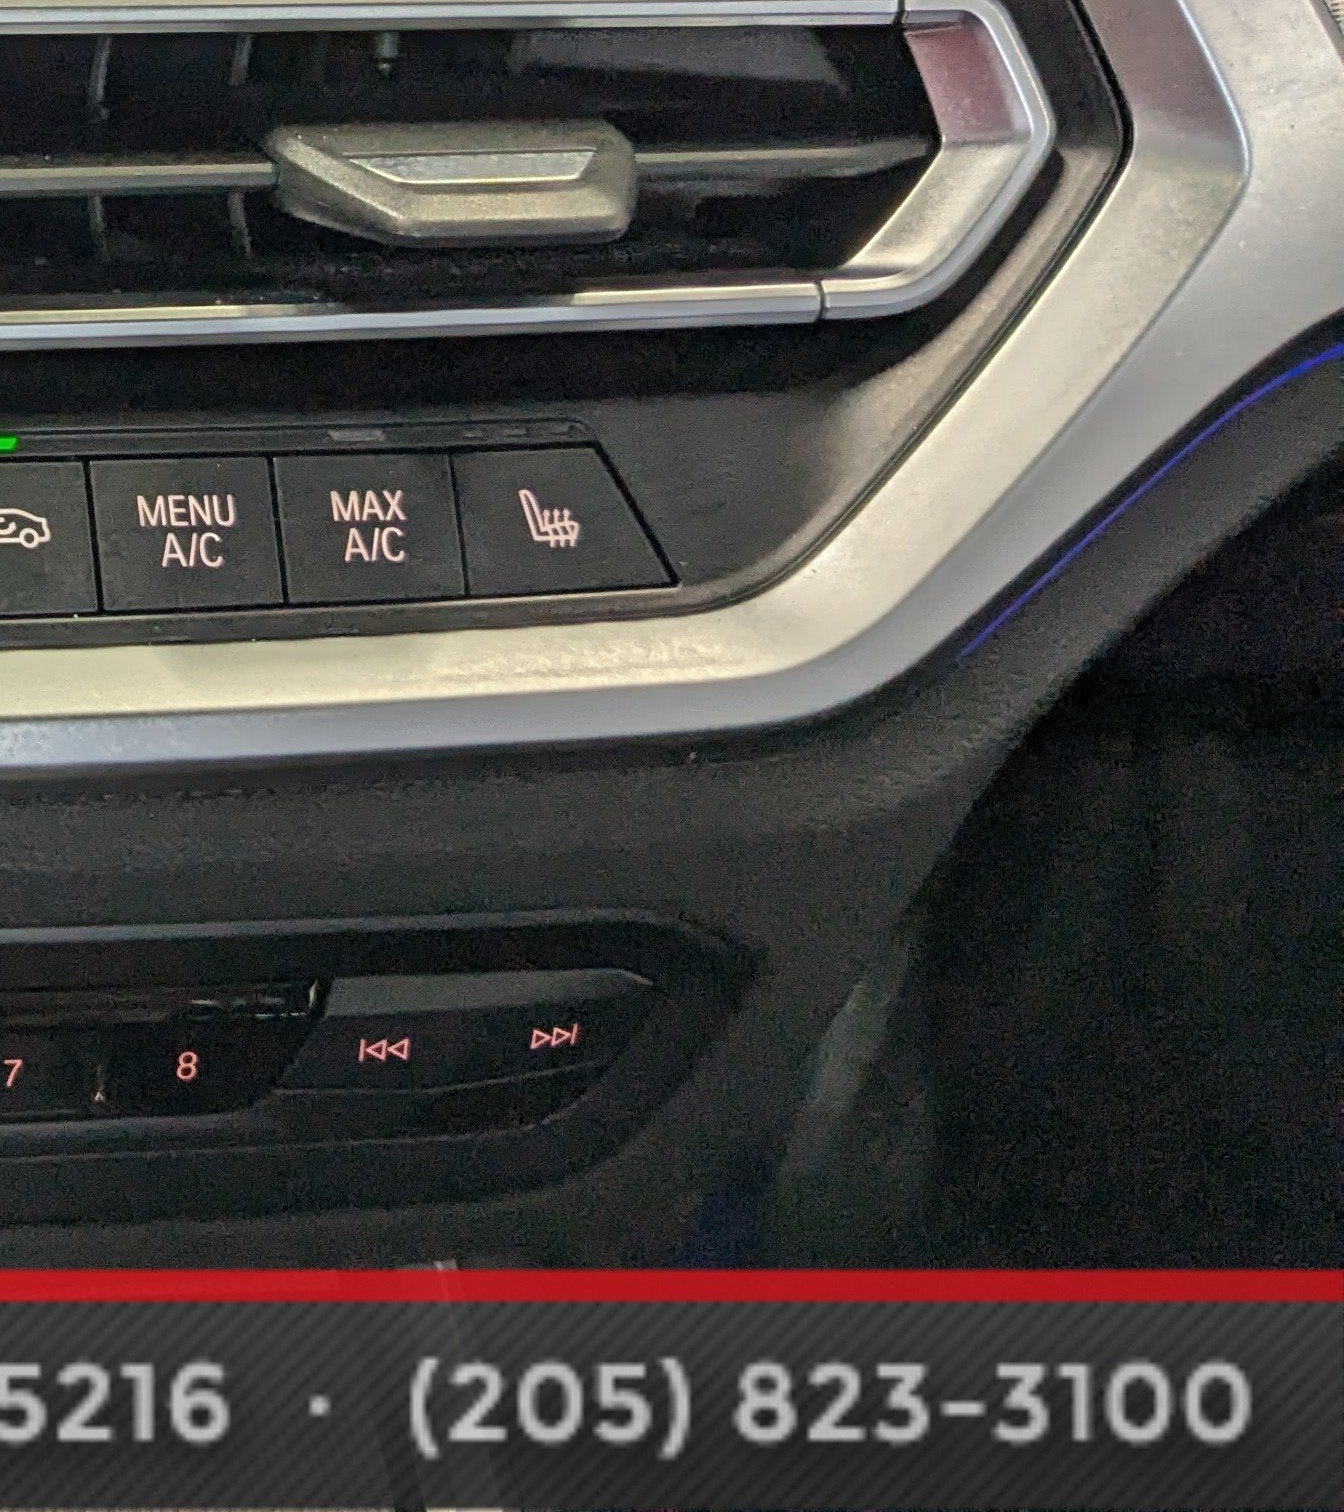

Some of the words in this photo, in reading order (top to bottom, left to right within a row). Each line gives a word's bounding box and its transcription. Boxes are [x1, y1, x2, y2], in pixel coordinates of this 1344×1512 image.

[137, 493, 236, 528] MENU
[330, 489, 408, 523] MAX
[161, 532, 224, 569] A/C
[344, 526, 406, 564] A/C
[2, 1058, 23, 1088] 7
[175, 1051, 200, 1082] 8
